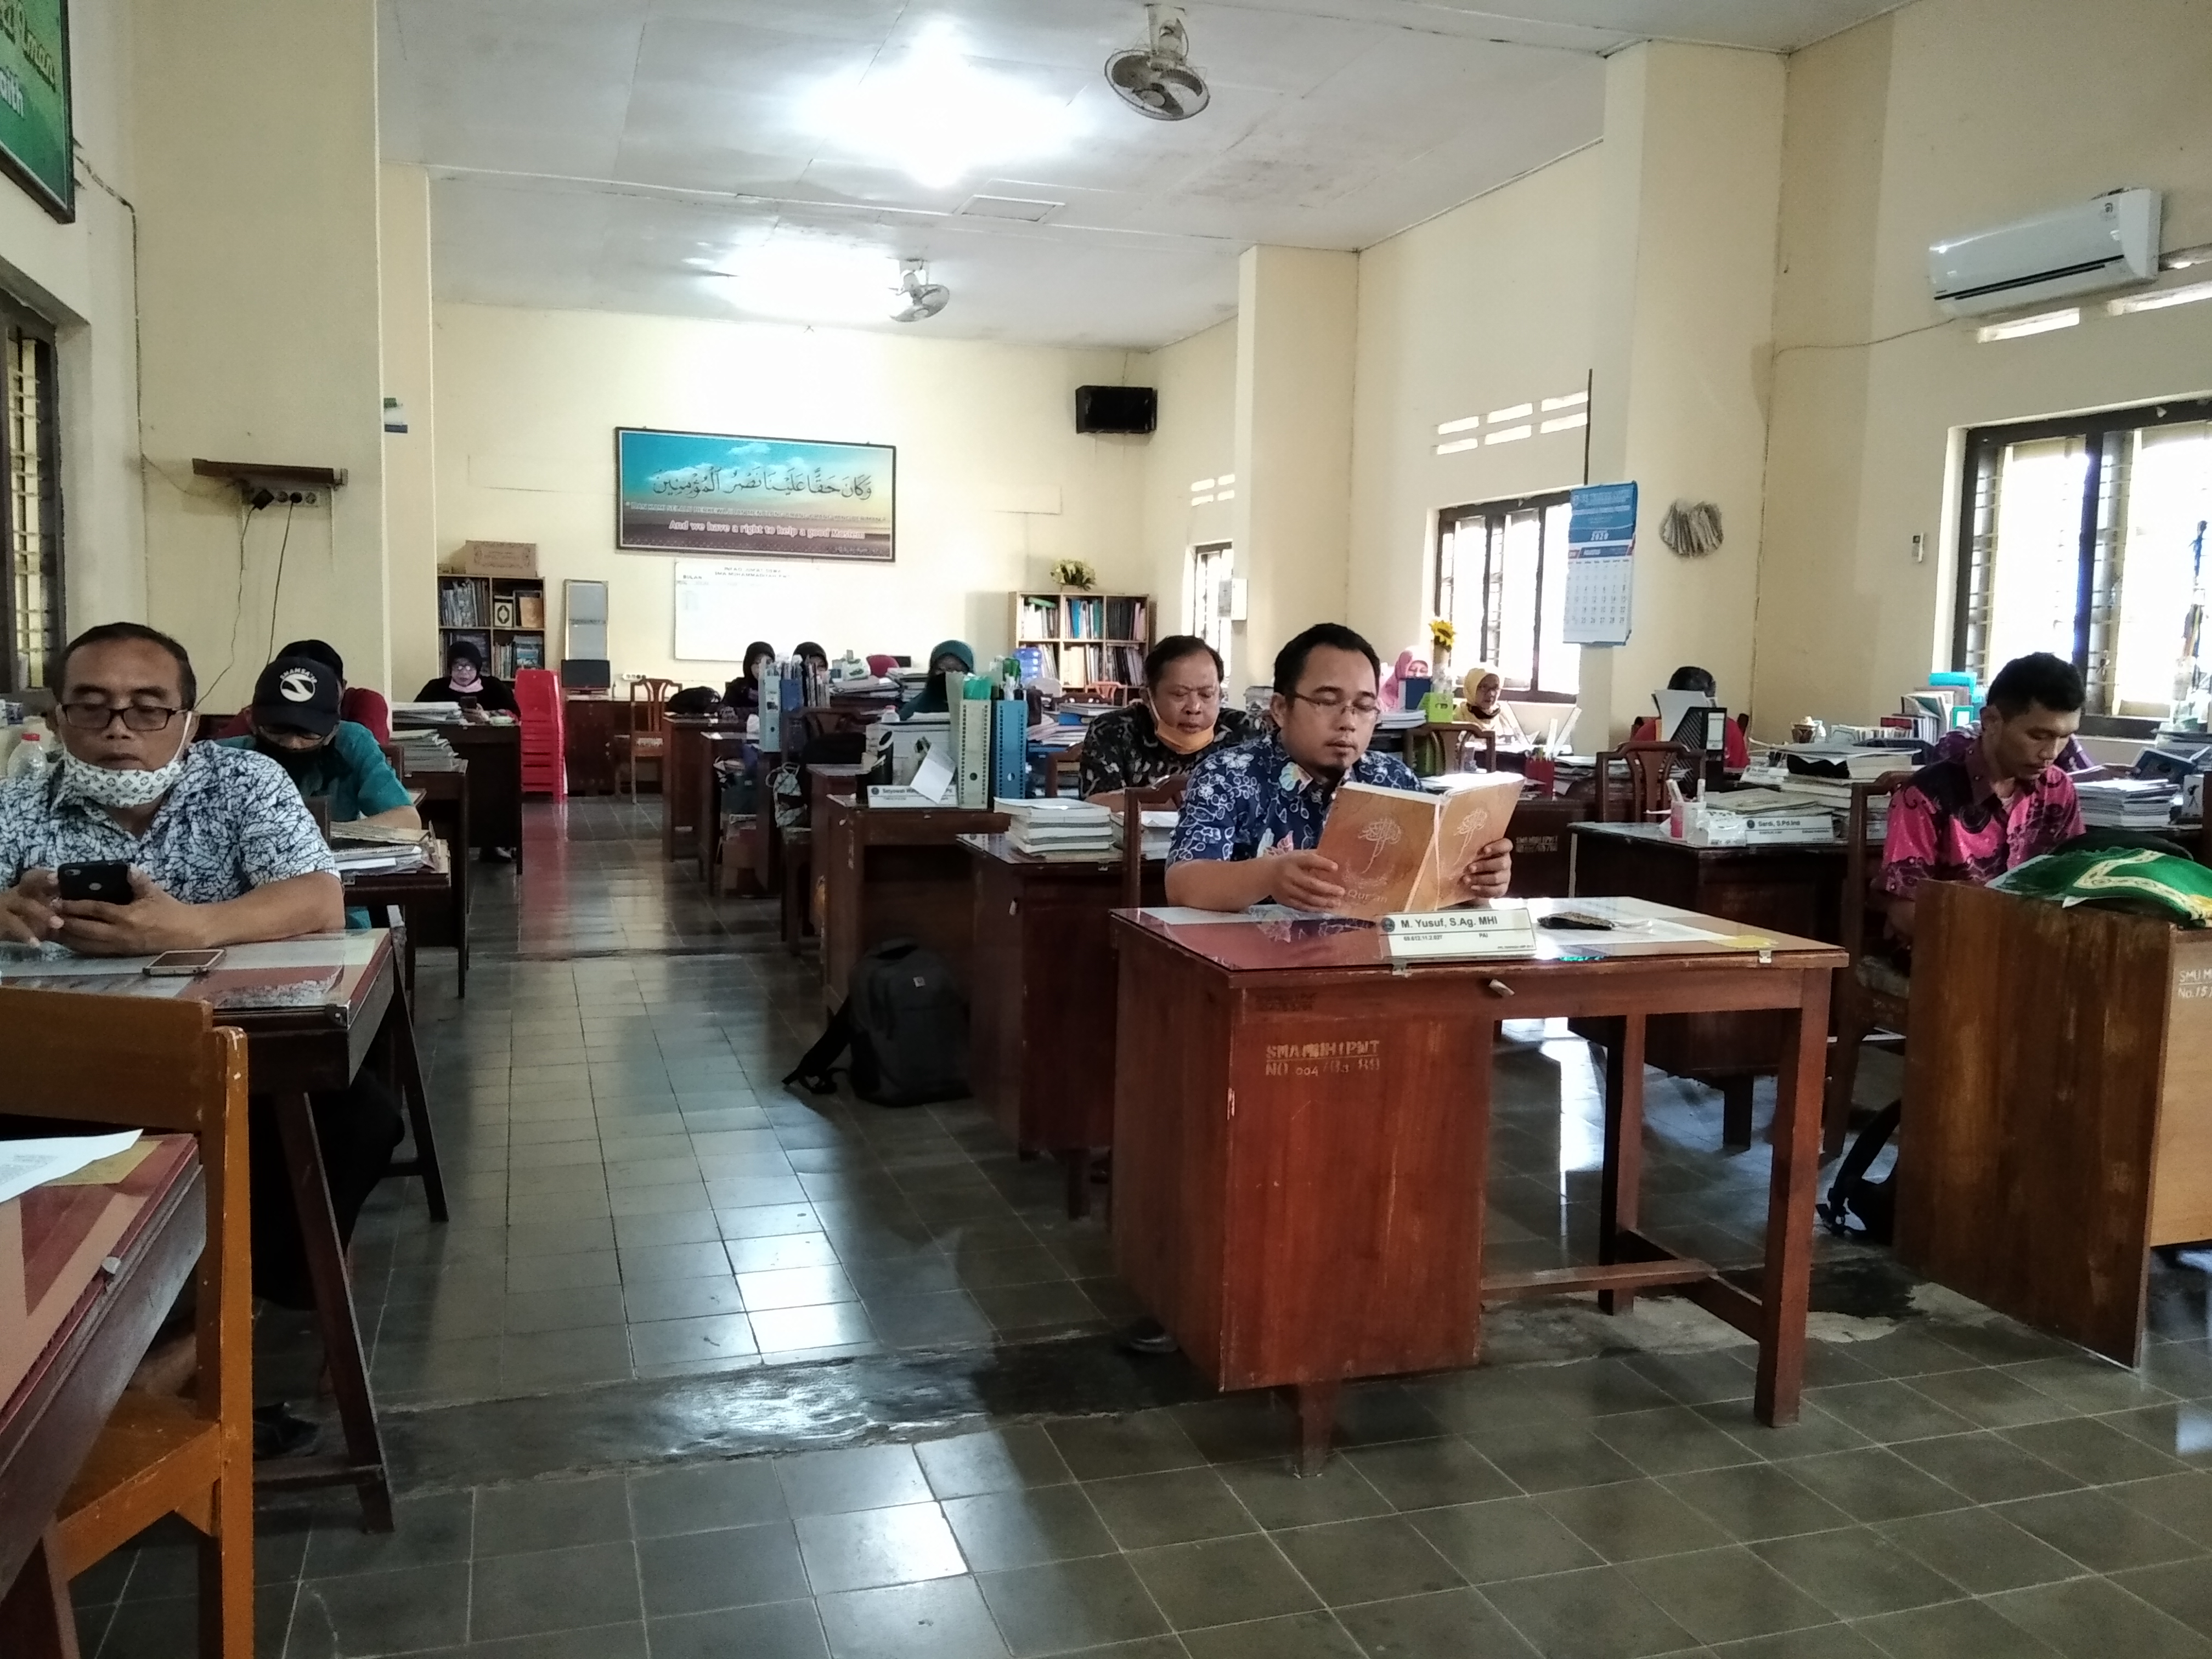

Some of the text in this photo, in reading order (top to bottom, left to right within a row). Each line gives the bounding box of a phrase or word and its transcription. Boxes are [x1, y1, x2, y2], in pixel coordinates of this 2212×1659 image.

[668, 519, 866, 539] And we have a right to help a good Moslem
[1401, 916, 1498, 929] M. Yusuf, S.Ag. MHI
[1295, 1066, 1319, 1076] 004
